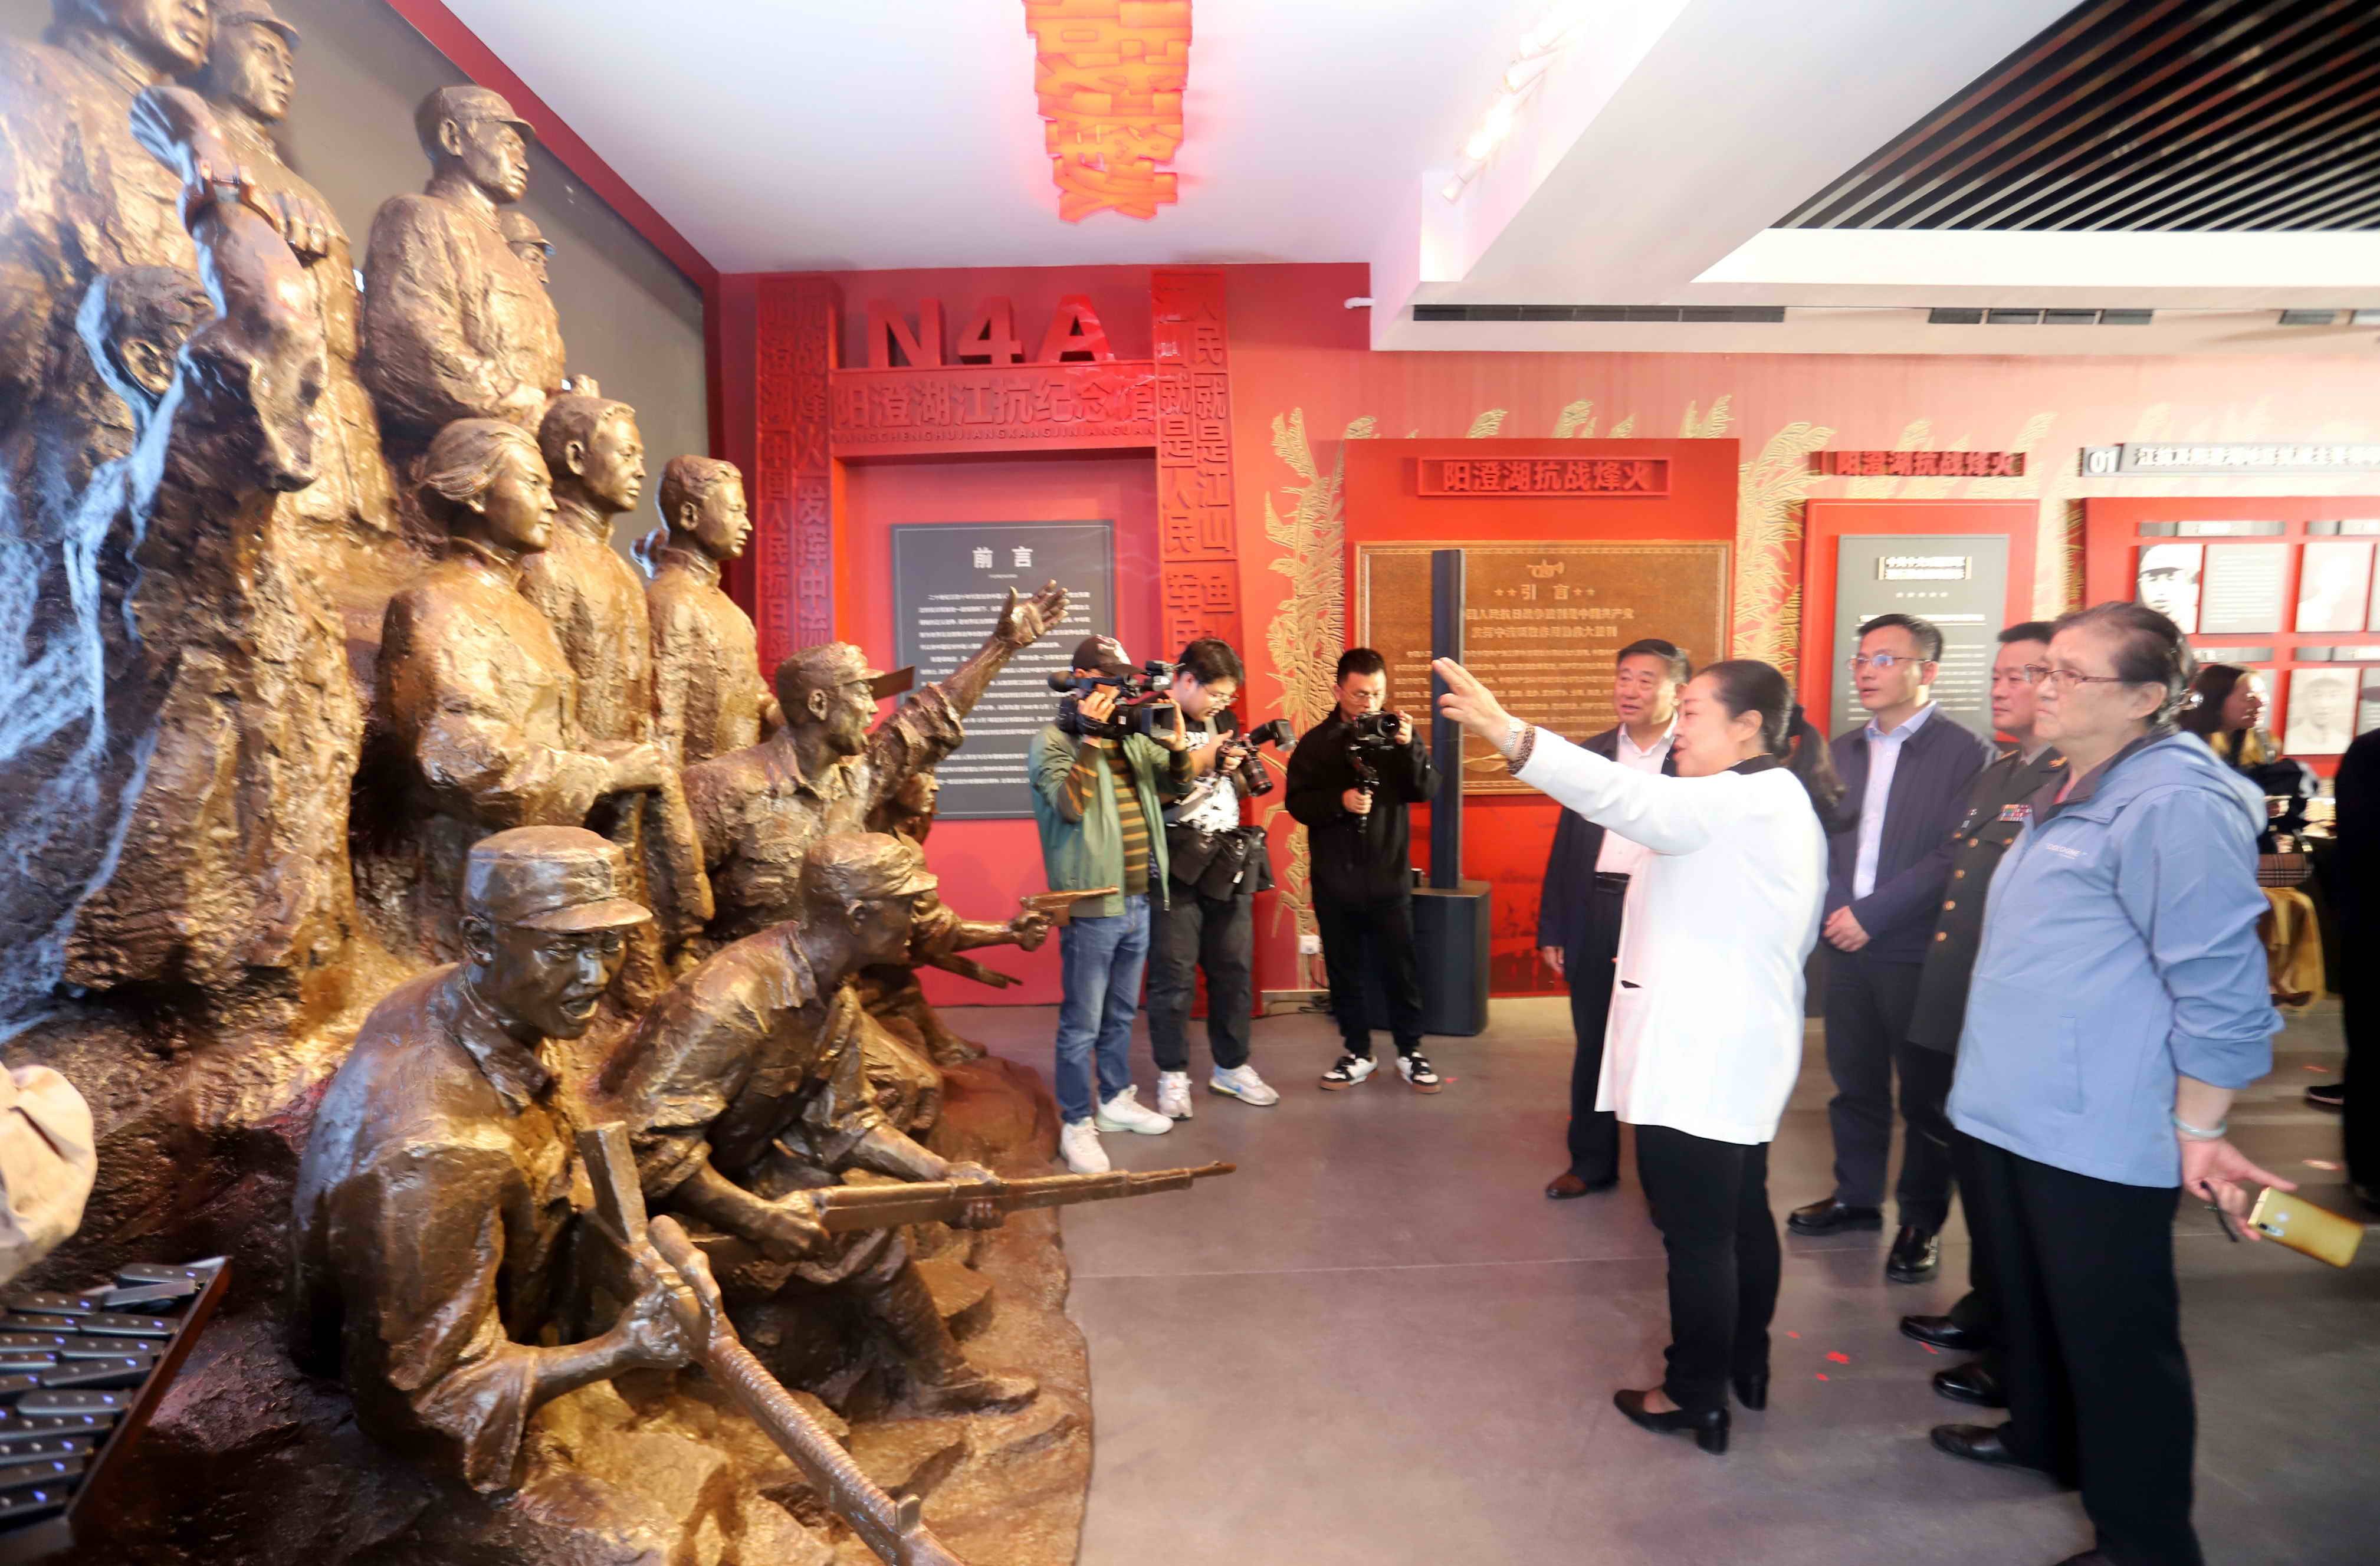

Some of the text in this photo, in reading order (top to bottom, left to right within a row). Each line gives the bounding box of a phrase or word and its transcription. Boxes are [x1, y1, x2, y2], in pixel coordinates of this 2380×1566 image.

[868, 293, 1117, 368] N4A
[833, 378, 1154, 429] 阳澄湖江抗纪念馆
[1837, 451, 2014, 475] 阳澄湖抗战烽火
[2089, 447, 2120, 473] 01
[1443, 461, 1649, 491] 阳澄湖抗战烽火
[972, 546, 1033, 569] 前言
[1521, 584, 1570, 600] 引言
